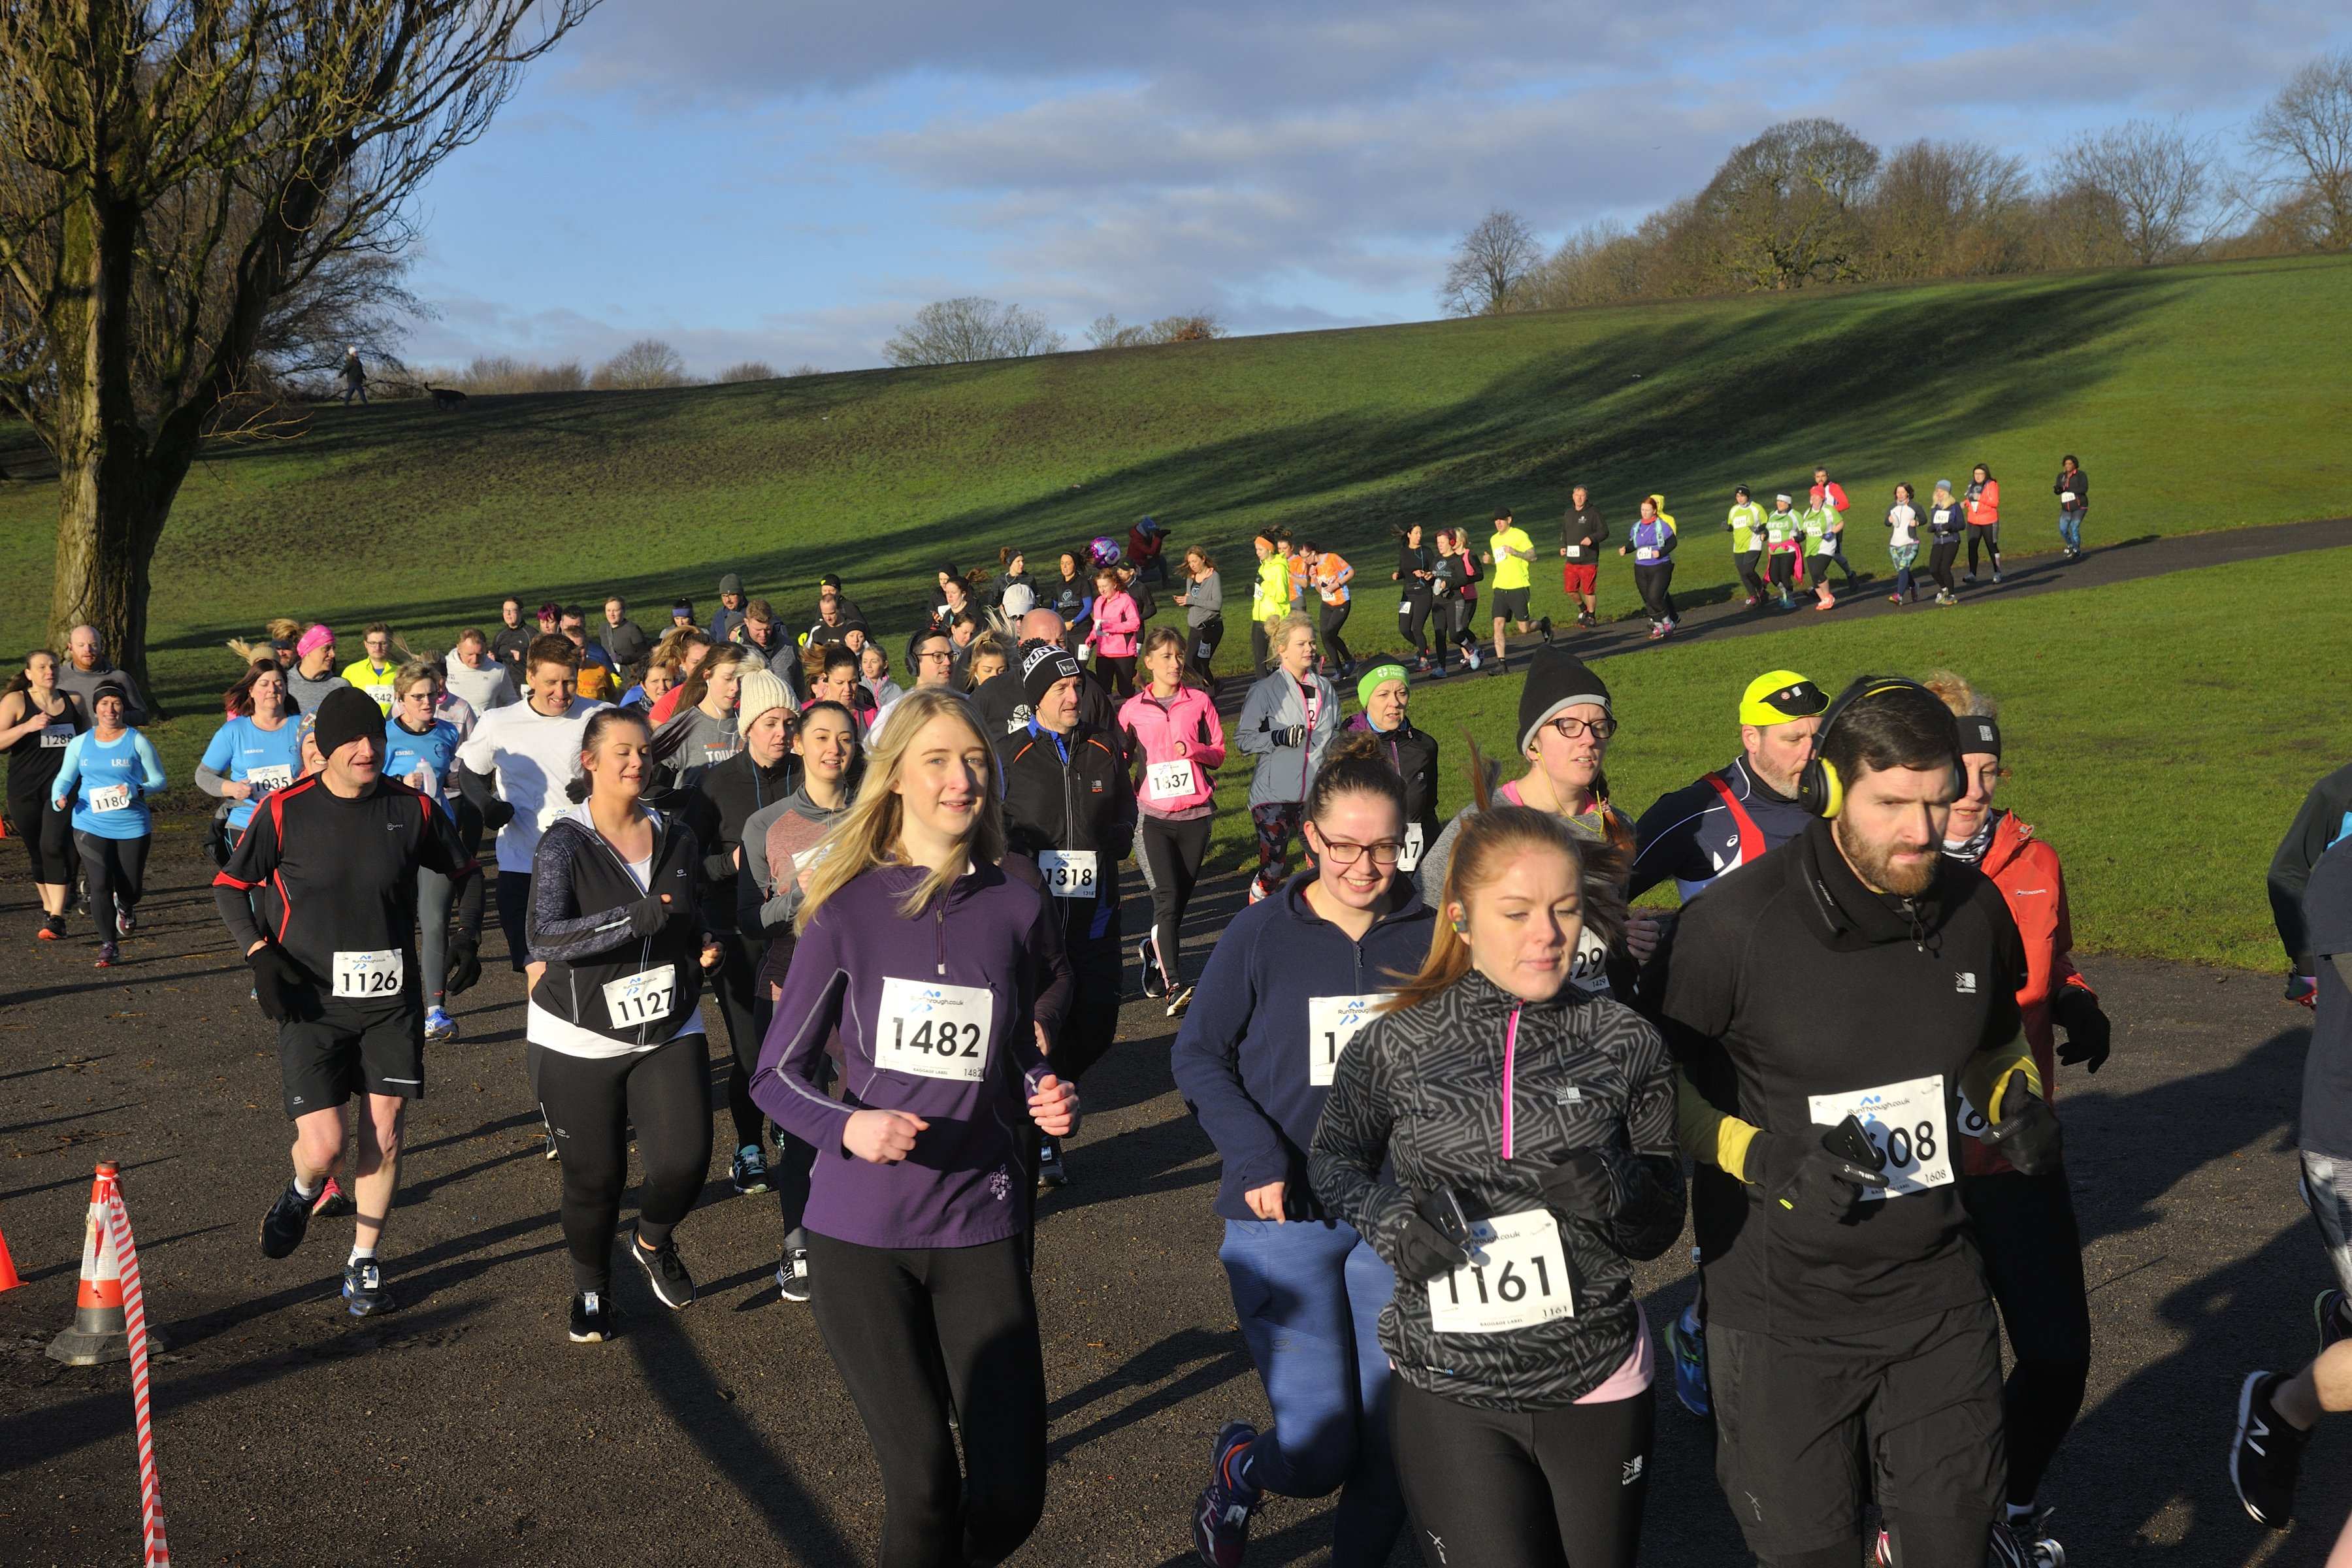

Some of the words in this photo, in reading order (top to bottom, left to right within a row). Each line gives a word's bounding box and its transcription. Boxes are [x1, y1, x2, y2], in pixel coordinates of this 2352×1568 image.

[255, 776, 289, 792] 1035
[95, 796, 127, 810] 1180
[1045, 868, 1092, 887] 1318
[342, 970, 398, 992] 1126
[617, 986, 674, 1021] 1127
[892, 1017, 981, 1058] 1482
[1924, 1169, 1947, 1183] 1608
[1445, 1255, 1552, 1305] 1161
[1542, 1305, 1569, 1318] 1161
